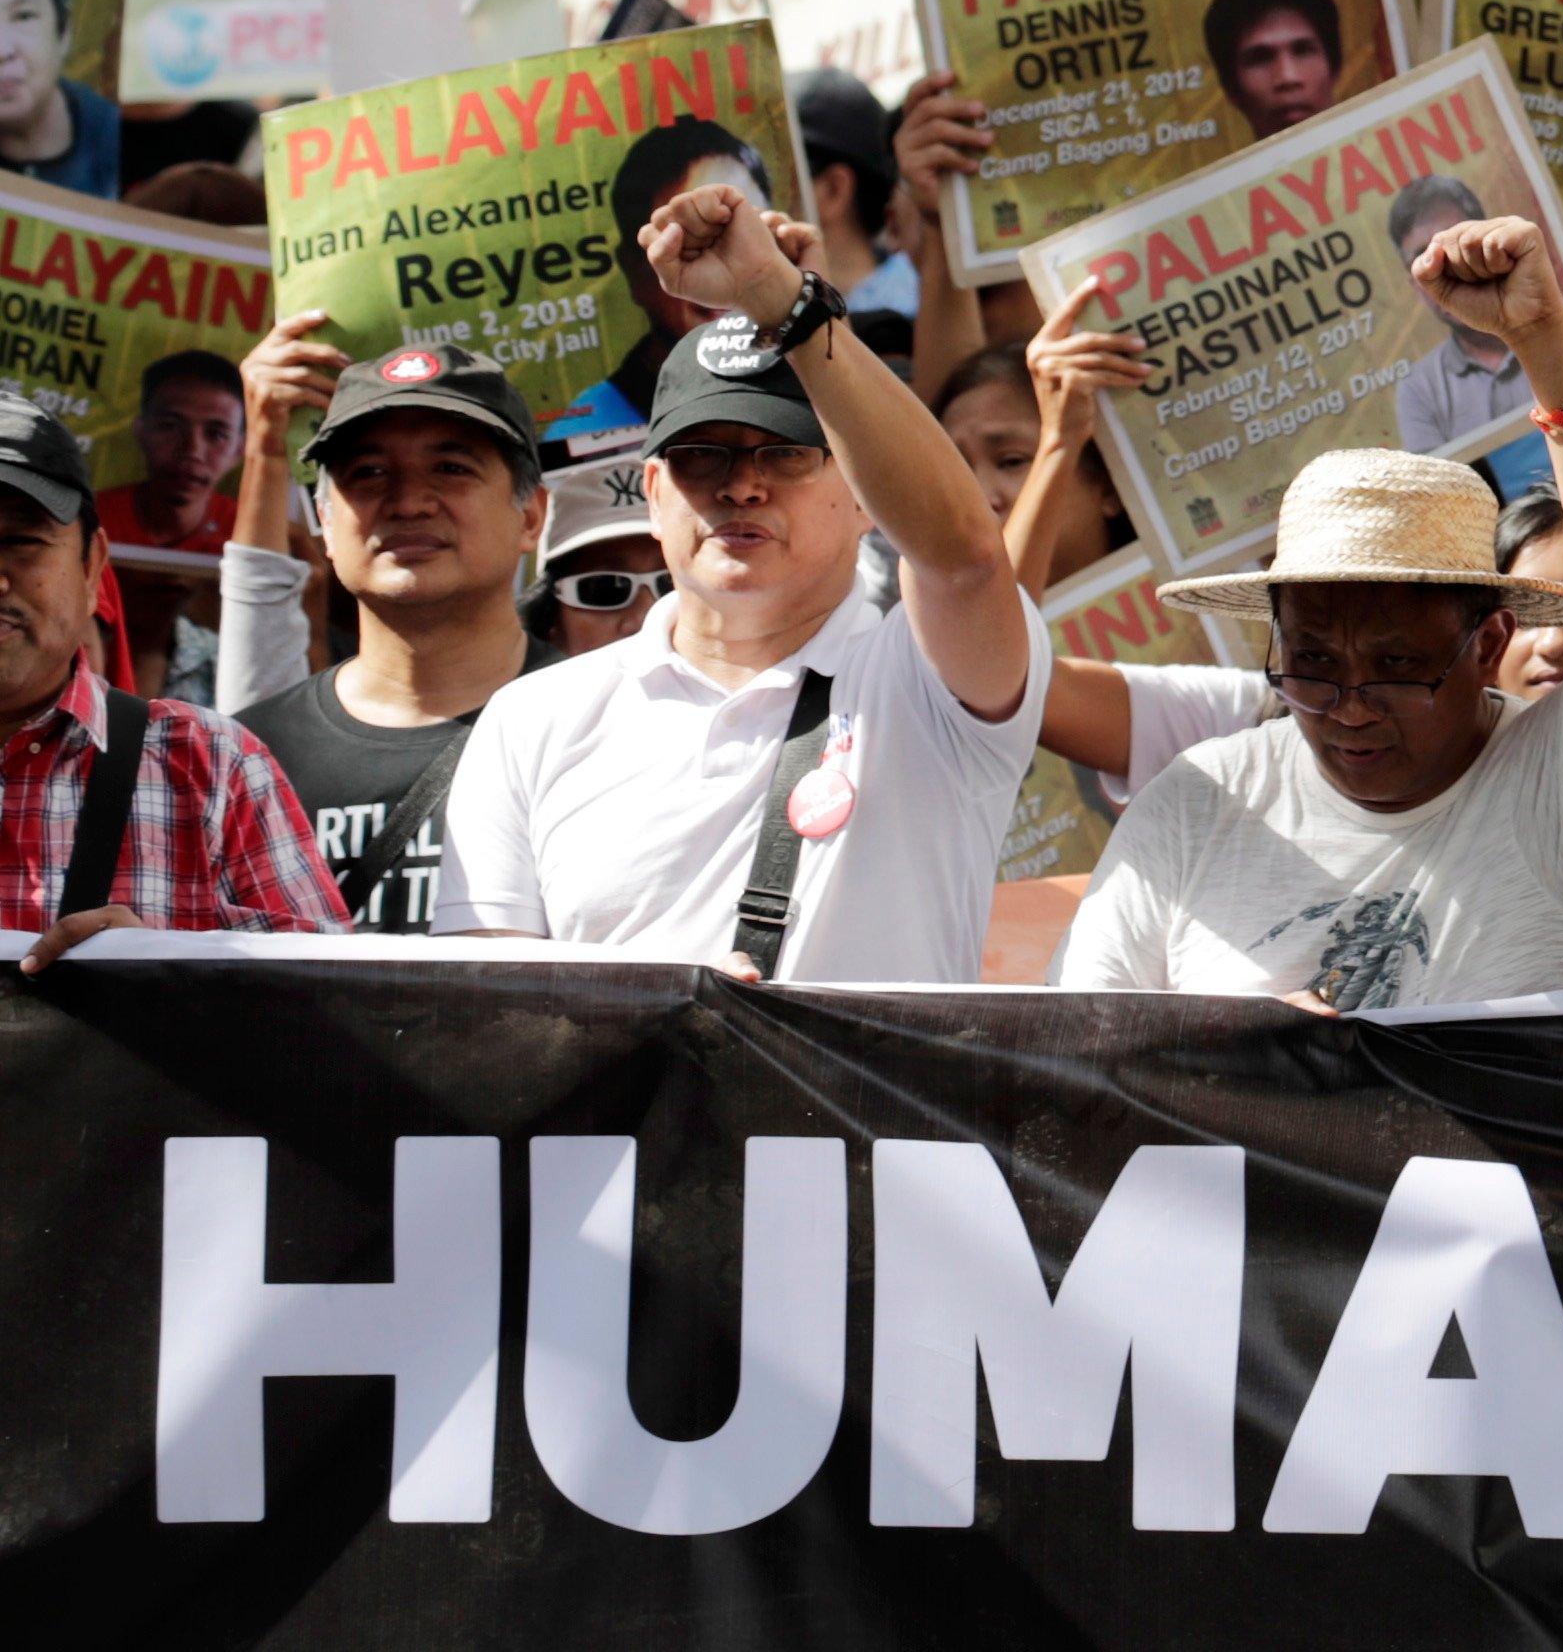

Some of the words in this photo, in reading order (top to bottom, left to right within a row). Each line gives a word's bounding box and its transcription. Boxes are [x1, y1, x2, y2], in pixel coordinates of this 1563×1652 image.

[1013, 32, 1155, 91] ORTIZ
[1103, 80, 1140, 105] 21,
[1144, 65, 1204, 97] 2012
[286, 43, 757, 202] PALAYAIN!
[979, 151, 1051, 181] Camp
[1056, 132, 1150, 167] Bagong
[1155, 118, 1218, 147] Diwa
[1039, 112, 1100, 144] SICA
[277, 224, 364, 278] Juan
[380, 177, 611, 246] Alexander
[1086, 93, 1486, 322] PALAYAIN!
[0, 216, 270, 334] LAYAIN
[395, 232, 616, 312] Reyes
[402, 320, 472, 347] June
[478, 311, 512, 337] 2,
[518, 294, 598, 330] 2018
[492, 338, 548, 365] City
[555, 326, 601, 360] Jail
[700, 333, 756, 352] MART
[716, 315, 749, 331] NO
[1138, 267, 1374, 399] CASTILLO
[718, 354, 761, 370] LAW!
[1155, 363, 1270, 426] February
[1277, 343, 1315, 374] 12,
[1317, 311, 1377, 357] 2017
[1163, 435, 1241, 480] Camp
[1245, 390, 1346, 445] Bagong
[1349, 358, 1412, 400] Diwa
[1229, 369, 1328, 424] SICA-1,
